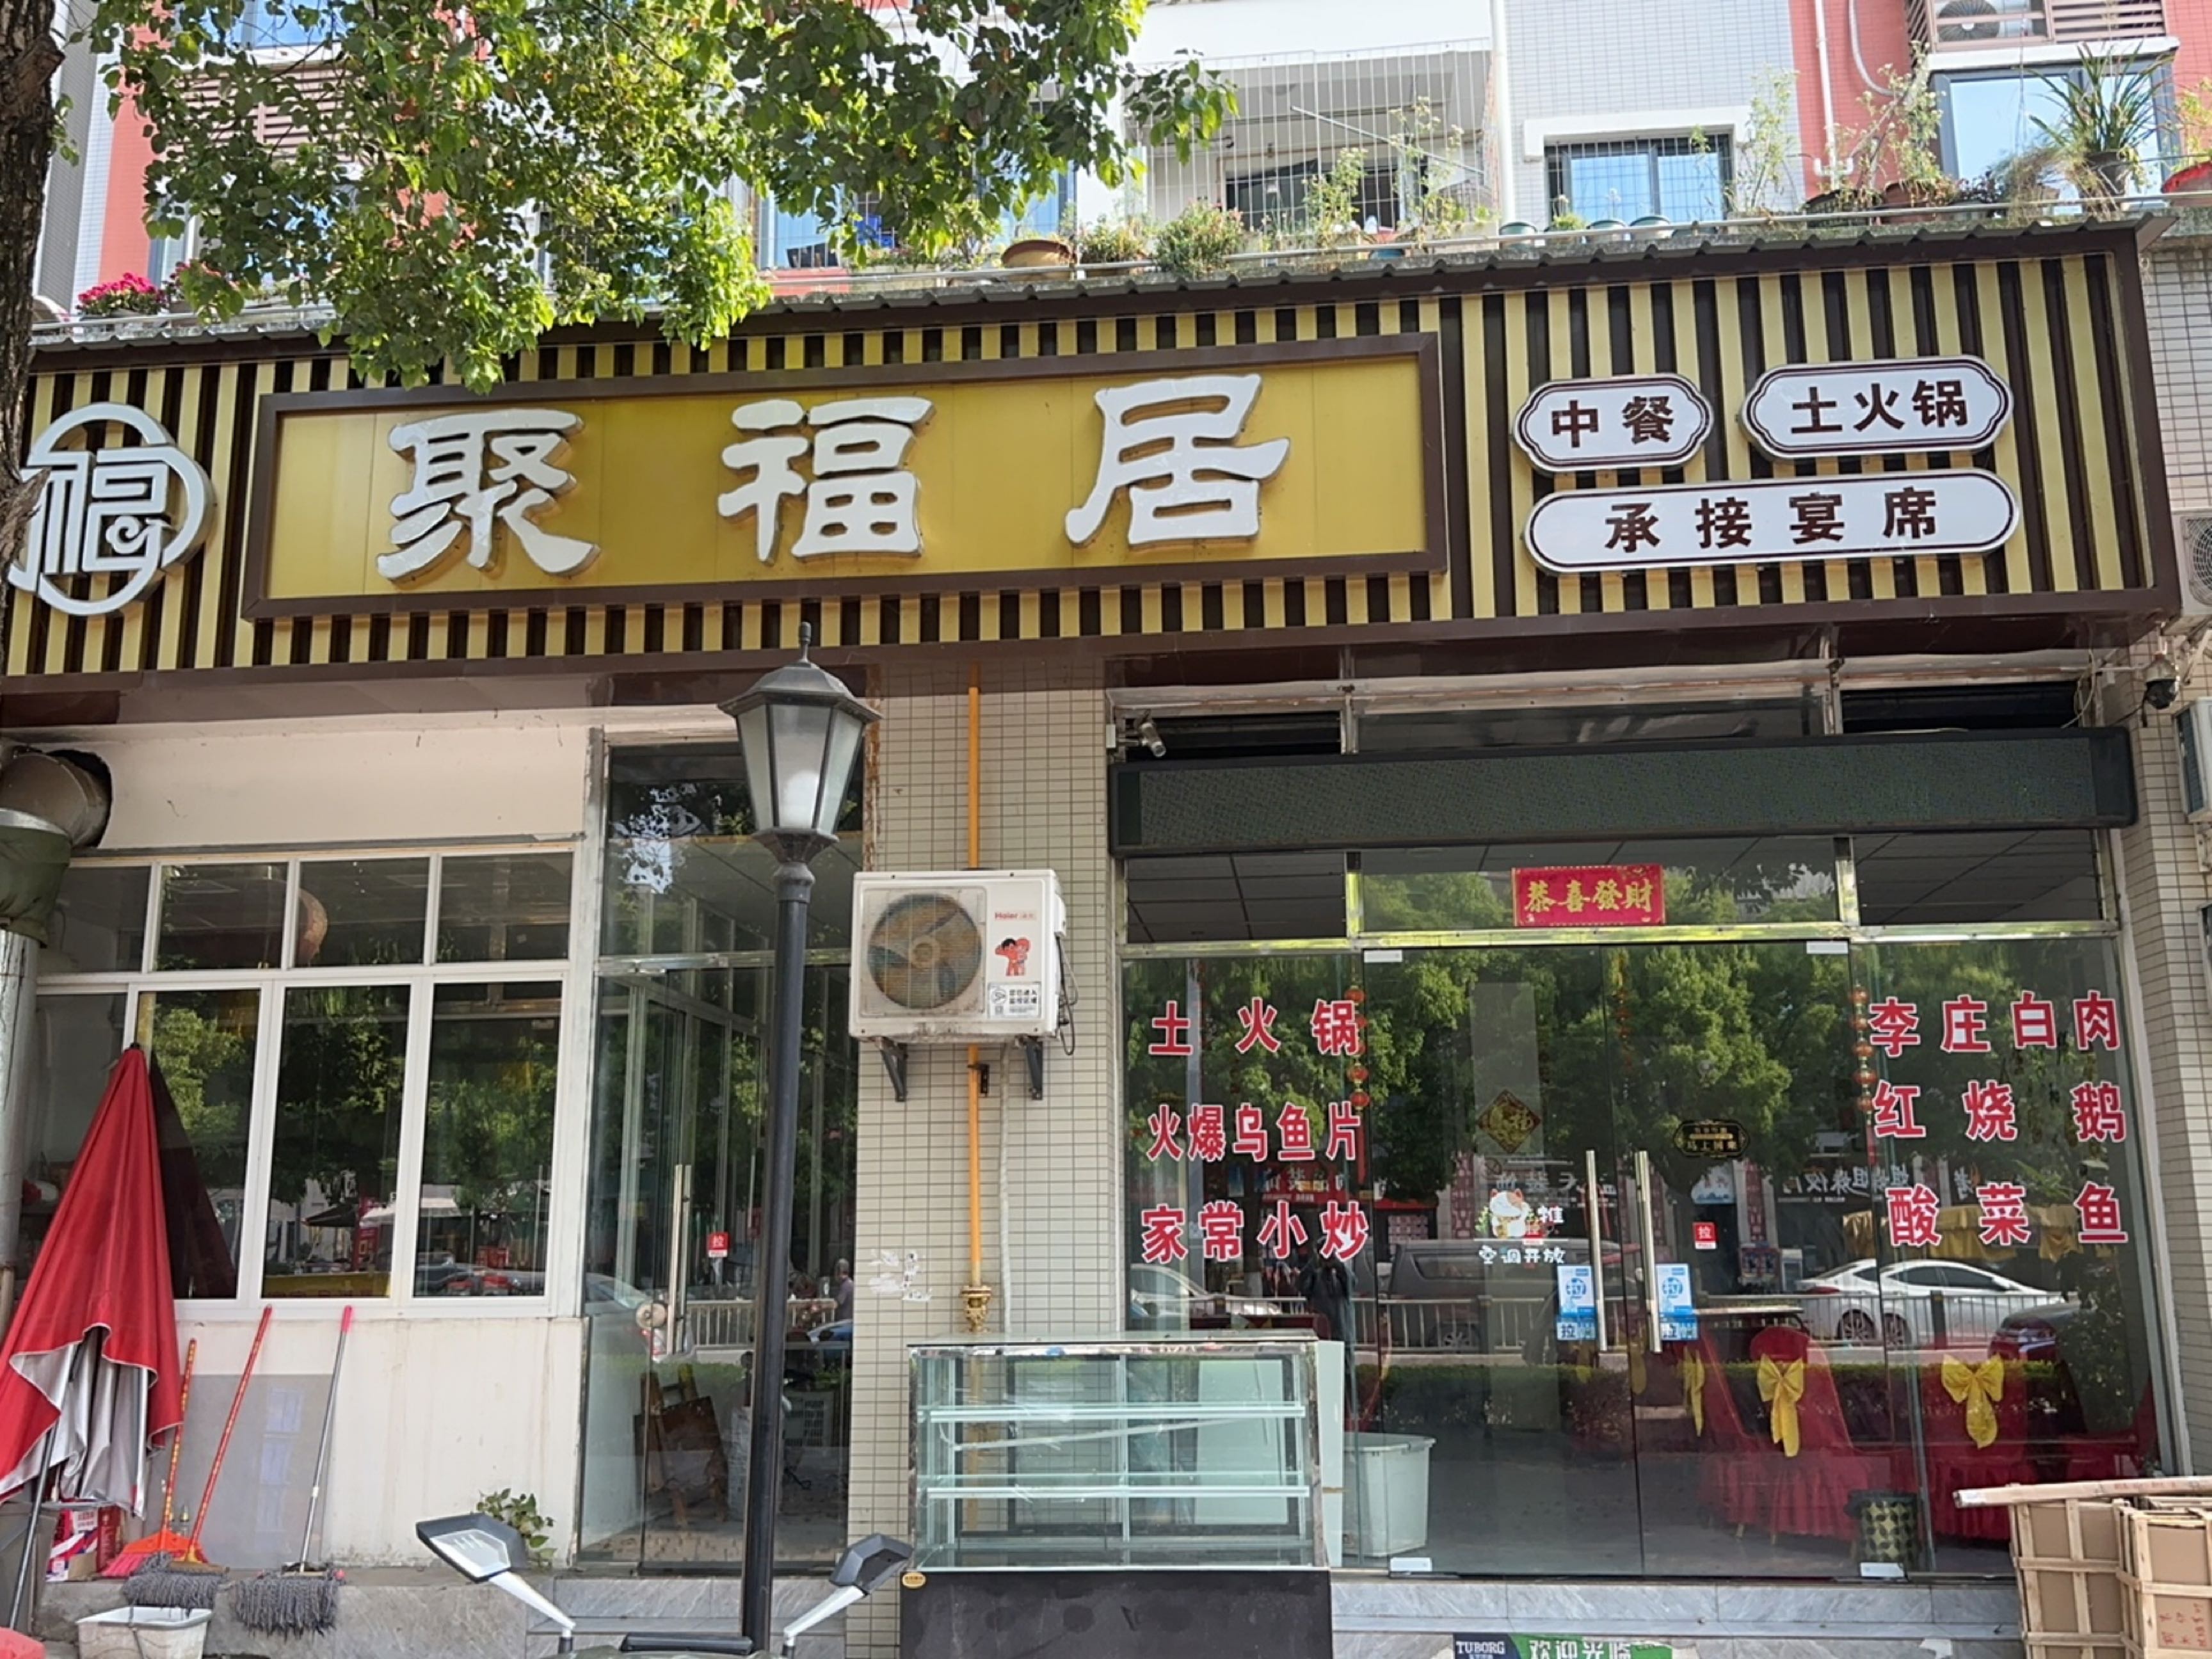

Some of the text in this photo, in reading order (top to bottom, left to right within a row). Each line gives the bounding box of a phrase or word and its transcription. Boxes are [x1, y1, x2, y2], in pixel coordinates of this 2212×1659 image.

[1551, 396, 1674, 448] 中餐
[1790, 378, 1969, 434] 土火锅
[376, 373, 1290, 584] 聚福居
[1605, 486, 1937, 554] 承接宴席
[1524, 879, 1654, 913] 恭喜發財
[1149, 996, 1362, 1057] 土火锅
[1868, 990, 2121, 1057] 李庄白肉
[1147, 1101, 1361, 1163] 火爆乌鱼片
[1873, 1080, 2128, 1143] 红烧鹅
[1141, 1200, 1370, 1264] 家常小炒
[1887, 1182, 2128, 1247] 酸菜鱼
[1479, 1244, 1566, 1264] 空调开放
[1456, 1640, 1506, 1655] TUBORG
[1528, 1639, 1631, 1659] 欢迎光临
